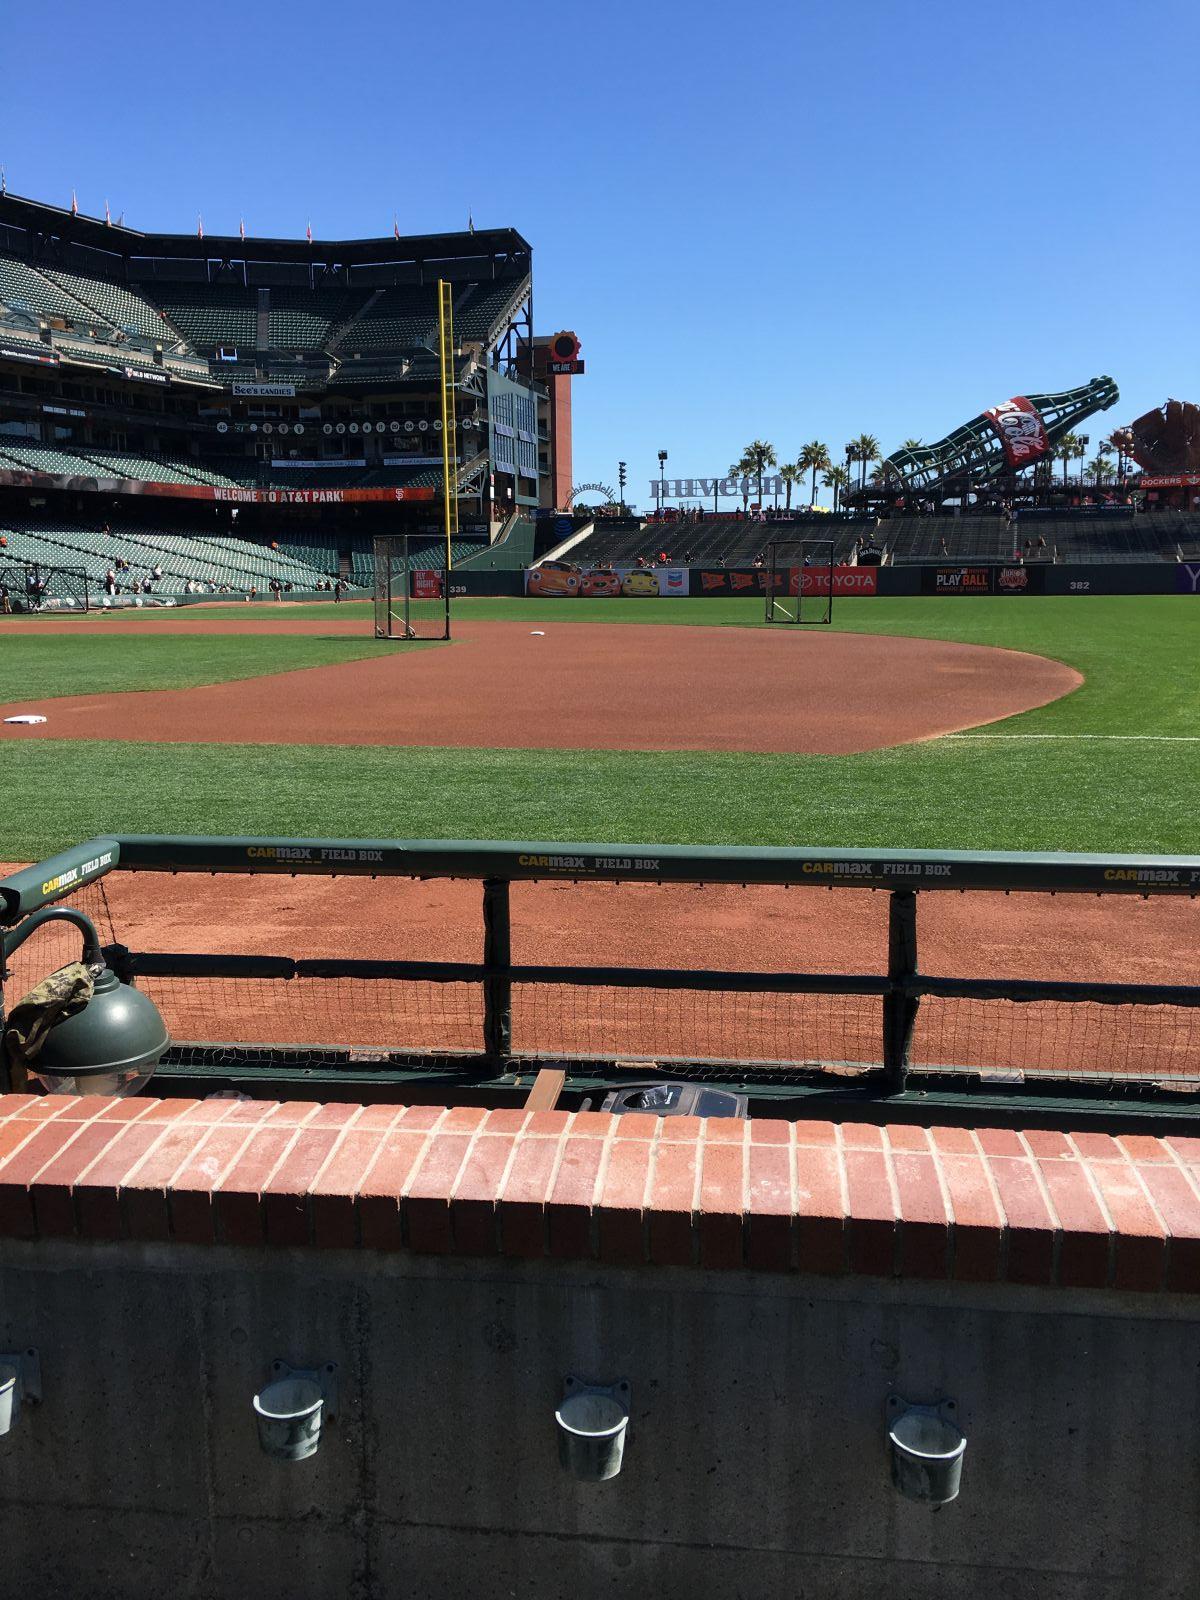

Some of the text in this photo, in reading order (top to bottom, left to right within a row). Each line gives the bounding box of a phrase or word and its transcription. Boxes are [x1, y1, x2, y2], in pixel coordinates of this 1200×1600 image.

[649, 475, 784, 498] nuveen
[1141, 477, 1182, 486] DOCKERS
[213, 488, 344, 503] WELCOME TO AT&T PARK!
[815, 575, 874, 587] TOYOTA
[936, 574, 988, 586] PLAY BALL
[1069, 581, 1090, 589] 382
[449, 585, 467, 593] 339
[320, 849, 356, 861] FIELD
[359, 850, 383, 862] BOX
[81, 857, 100, 876] FIELD
[99, 852, 112, 867] BOX
[594, 857, 633, 869] FIELD
[634, 859, 660, 870] BOX
[882, 863, 922, 875] FIELD
[924, 864, 952, 876] BOX
